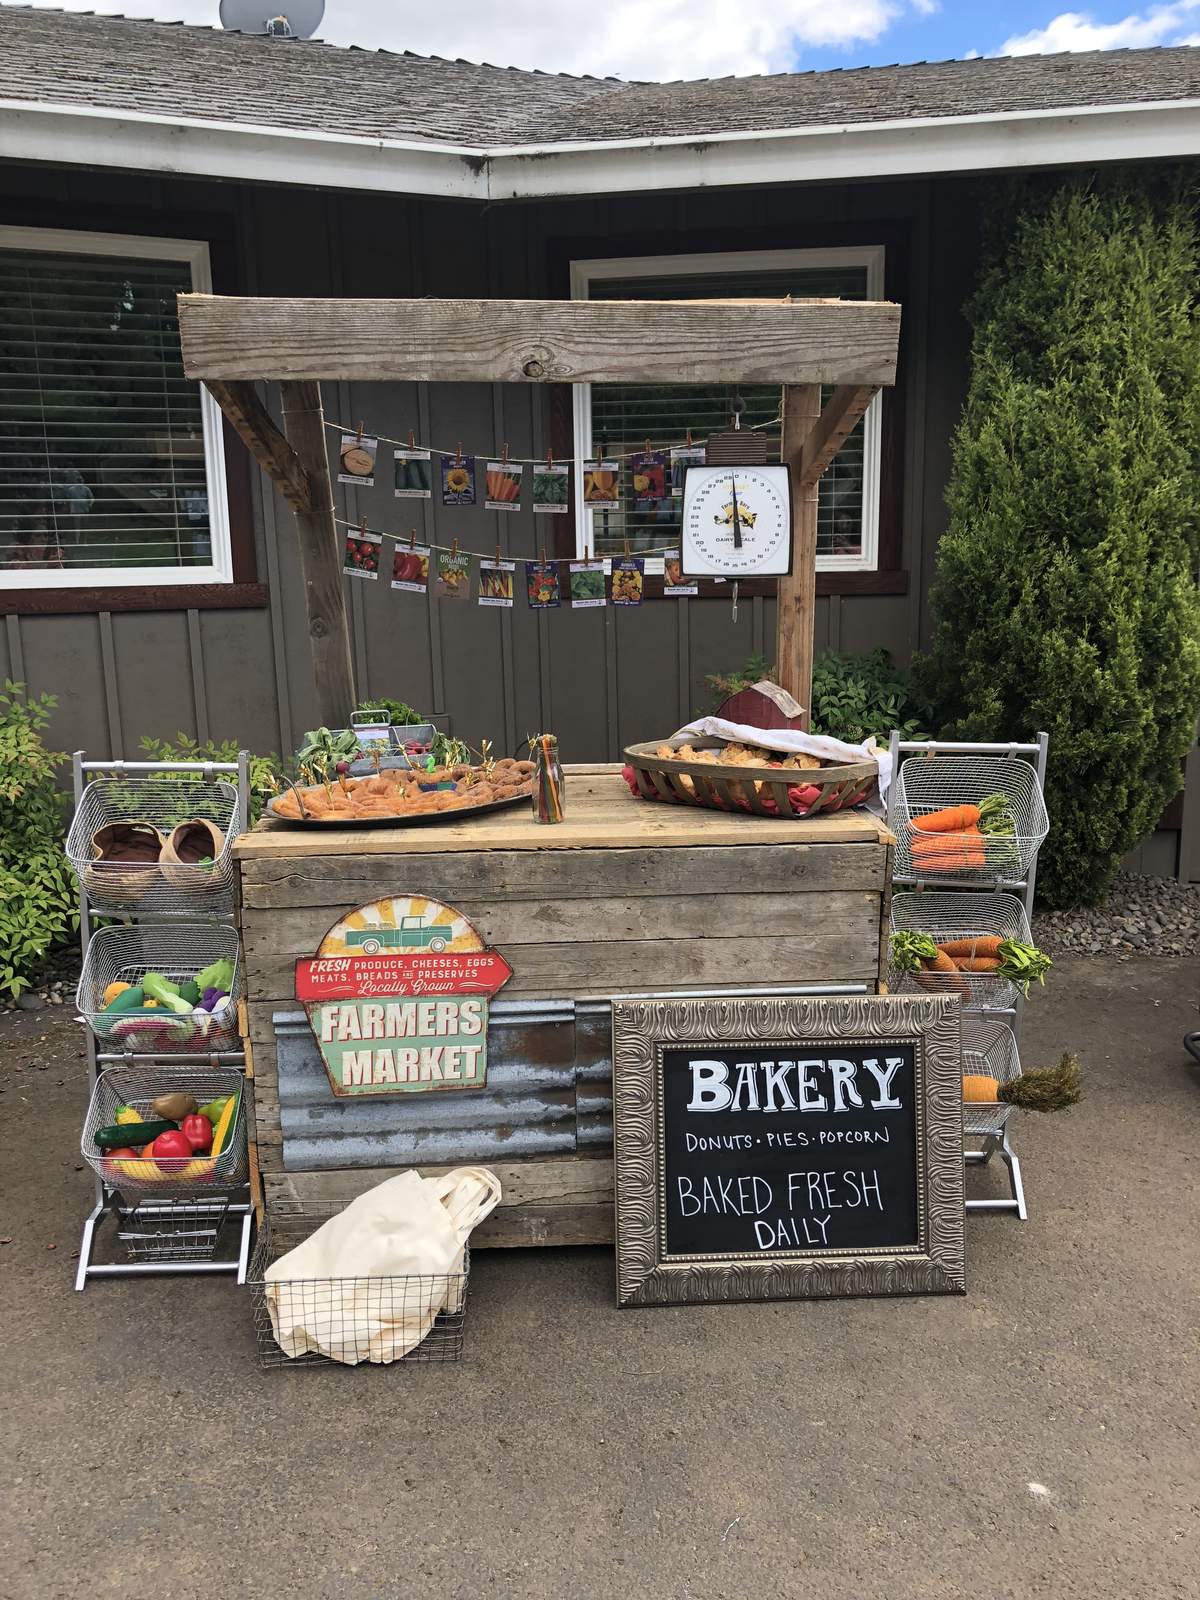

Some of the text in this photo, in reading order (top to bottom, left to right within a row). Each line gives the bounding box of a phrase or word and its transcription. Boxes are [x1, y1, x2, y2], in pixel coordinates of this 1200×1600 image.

[440, 554, 469, 566] ORGANIC
[309, 959, 352, 973] FRESH
[467, 958, 494, 967] EGGS
[356, 971, 398, 980] BREADS
[418, 969, 478, 979] PRESERVES
[357, 979, 455, 996] Locally Grown
[320, 1000, 483, 1042] FARMERS
[341, 1045, 483, 1087] MARKET
[686, 1057, 904, 1113] BAKERY
[819, 1126, 890, 1145] POPCORN
[678, 1169, 883, 1217] BAKED FRESH
[753, 1214, 831, 1249] DAILY
